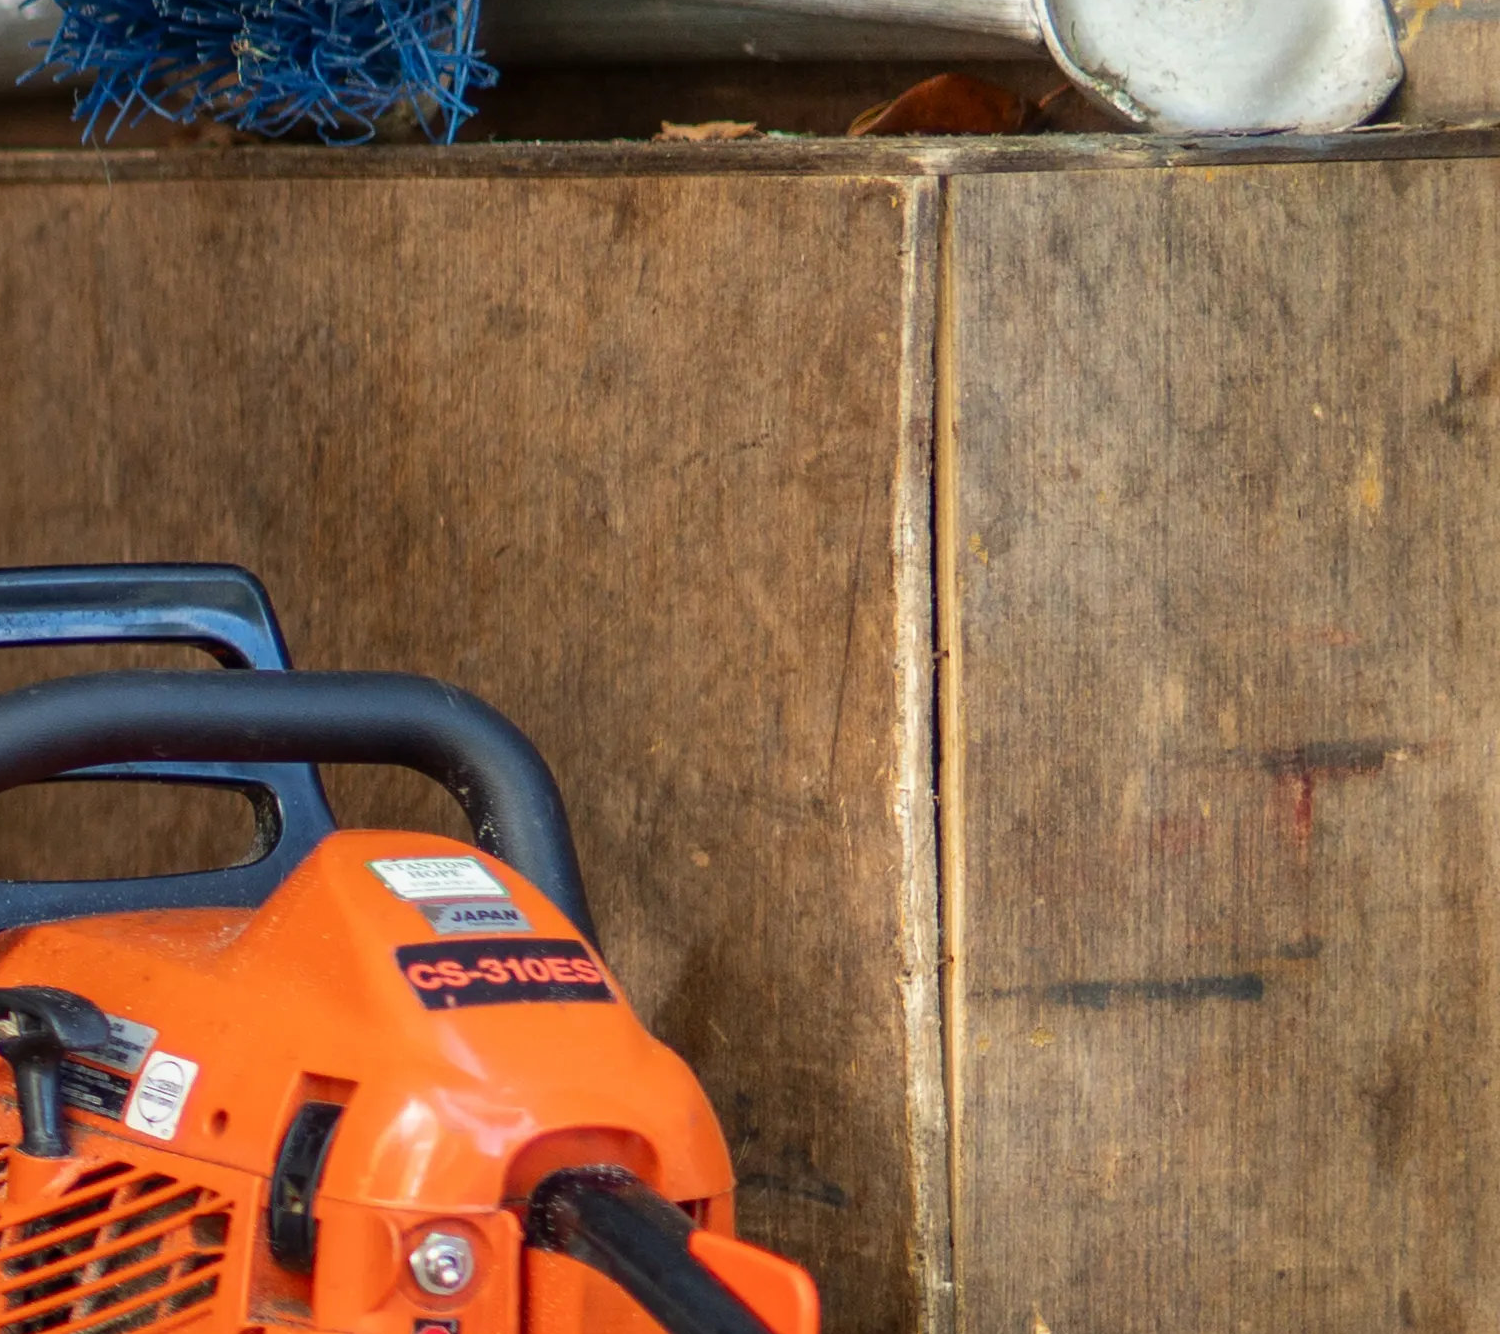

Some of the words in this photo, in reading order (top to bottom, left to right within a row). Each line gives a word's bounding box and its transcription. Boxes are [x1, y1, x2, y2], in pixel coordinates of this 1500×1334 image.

[382, 860, 473, 872] STANTON
[407, 870, 464, 879] HOPE
[450, 909, 520, 922] JAPAN
[407, 957, 603, 990] CS-310ES
